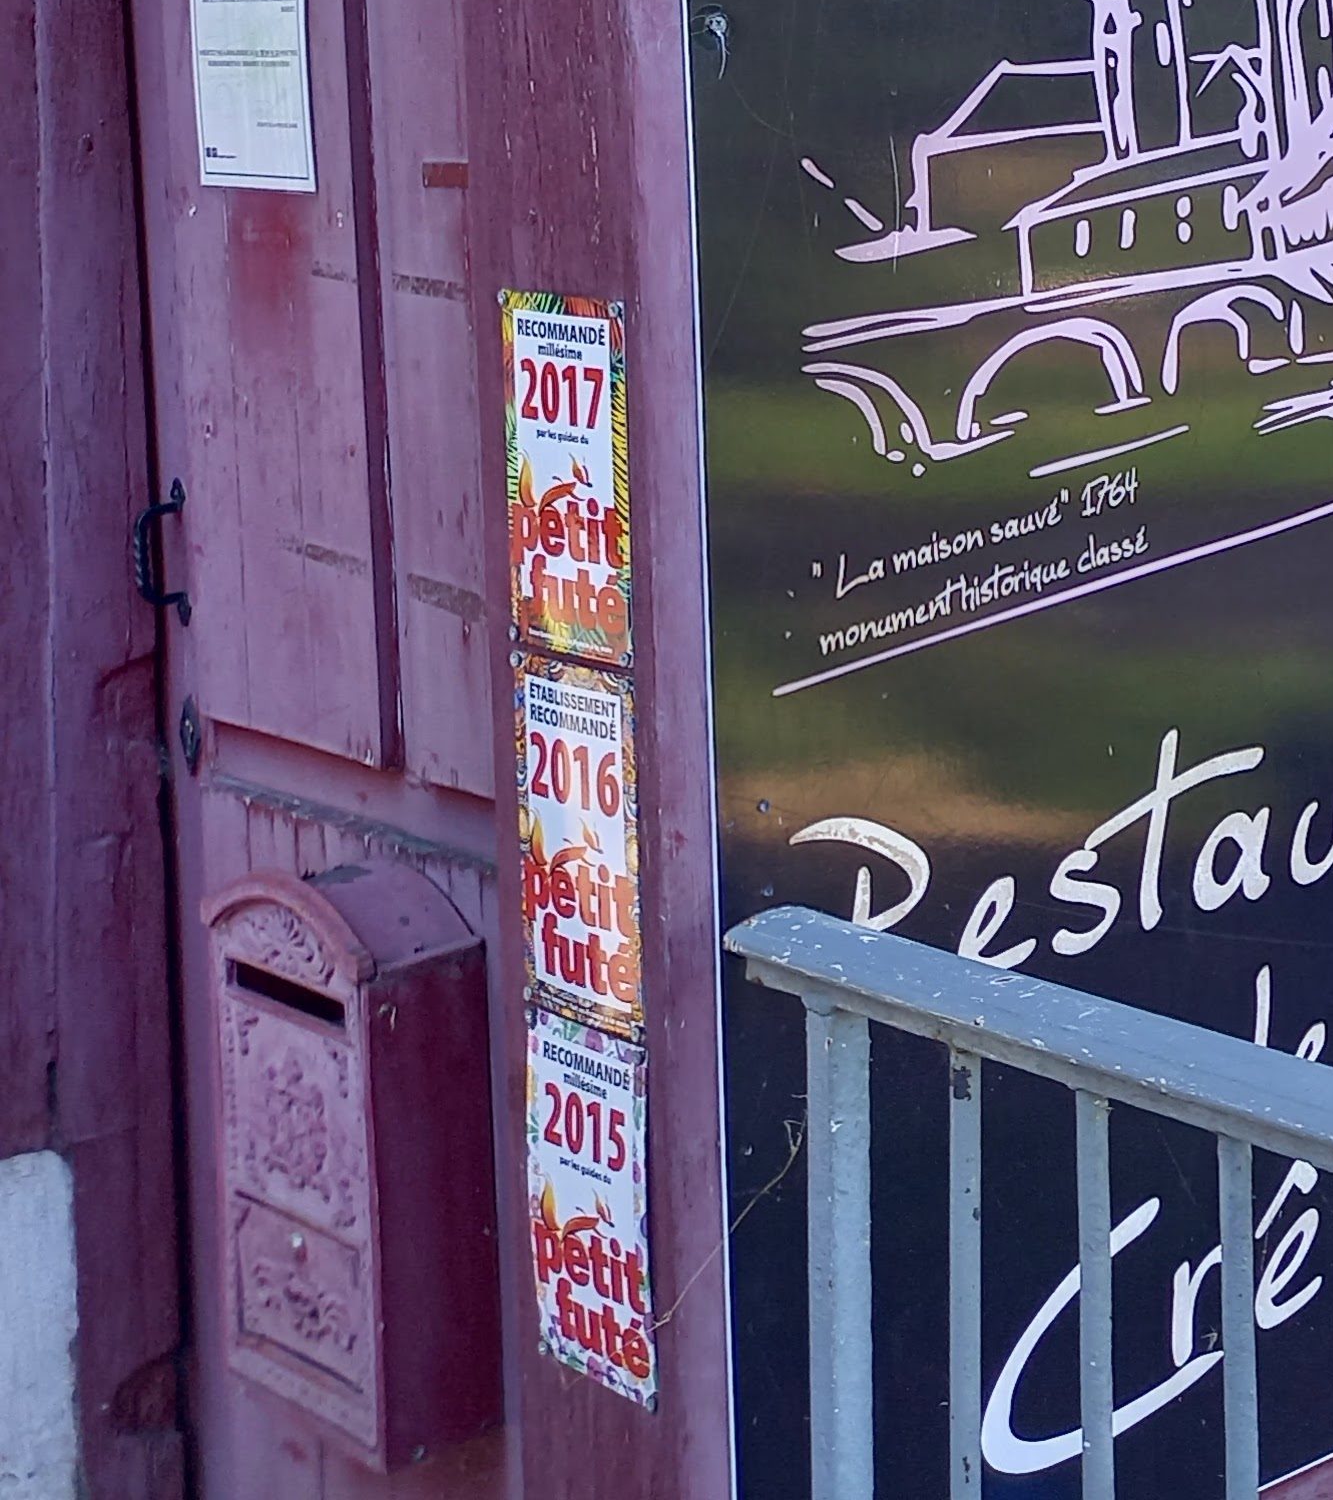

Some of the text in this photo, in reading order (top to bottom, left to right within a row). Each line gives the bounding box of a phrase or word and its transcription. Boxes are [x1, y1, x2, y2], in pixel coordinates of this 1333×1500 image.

[517, 318, 606, 346] RECOMMANDÉ
[538, 343, 583, 361] millésime
[520, 358, 604, 429] 2017
[536, 429, 589, 445] par les guides du
[511, 498, 625, 569] petit
[891, 531, 985, 575] maison
[1080, 467, 1139, 518] 1764
[528, 553, 627, 635] futé
[819, 526, 1150, 655] monument historique classé
[529, 679, 618, 720] ÉTABLISSEMENT
[529, 703, 618, 743] RECOMMANDÉ
[530, 731, 621, 818] 2016
[524, 857, 637, 938] petit
[541, 911, 640, 1003] futé
[543, 1041, 631, 1091] RECOMMANDÉ
[563, 1072, 608, 1100] millésime
[544, 1082, 626, 1172] 2015
[560, 1156, 612, 1186] par les guides du
[533, 1220, 645, 1316] petit
[555, 1277, 651, 1379] futé
